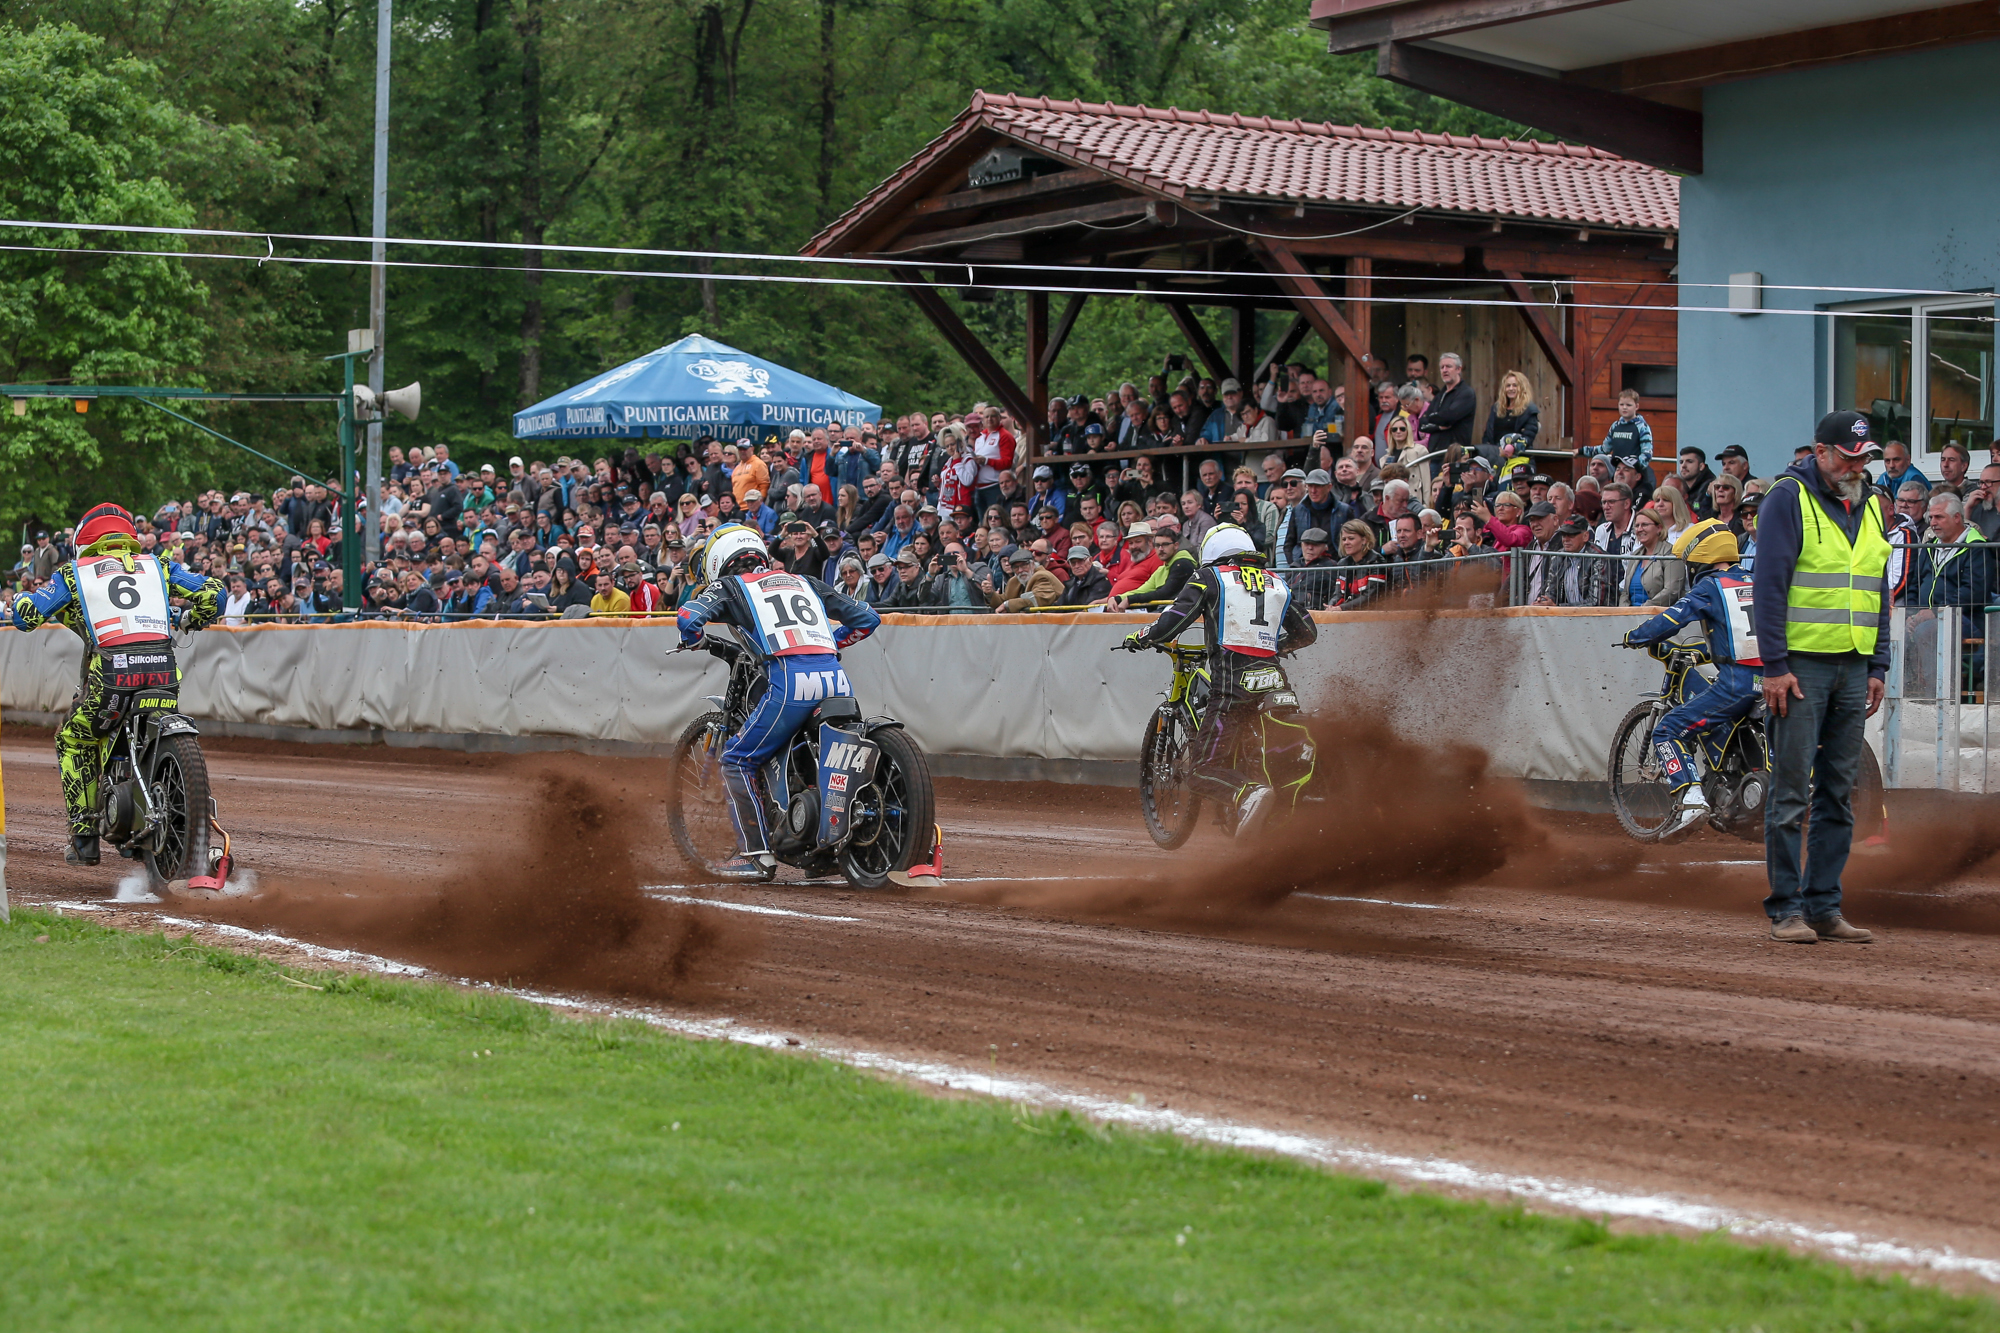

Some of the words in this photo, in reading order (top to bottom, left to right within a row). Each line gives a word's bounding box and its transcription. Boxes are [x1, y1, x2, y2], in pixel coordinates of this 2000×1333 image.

[518, 412, 557, 434] PUNTIGAMER
[566, 407, 605, 424] PUNTIGAMER
[624, 405, 730, 423] PUNTIGAMER
[762, 403, 866, 427] PUNTIGAMER
[108, 576, 141, 610] 6
[764, 594, 818, 628] 16
[1250, 590, 1269, 626] 1
[128, 655, 168, 665] Silkolene
[115, 672, 171, 687] FABVENT
[794, 669, 850, 701] MT4
[160, 698, 177, 709] GAPP
[824, 741, 872, 774] MT4
[830, 774, 848, 787] NGK
